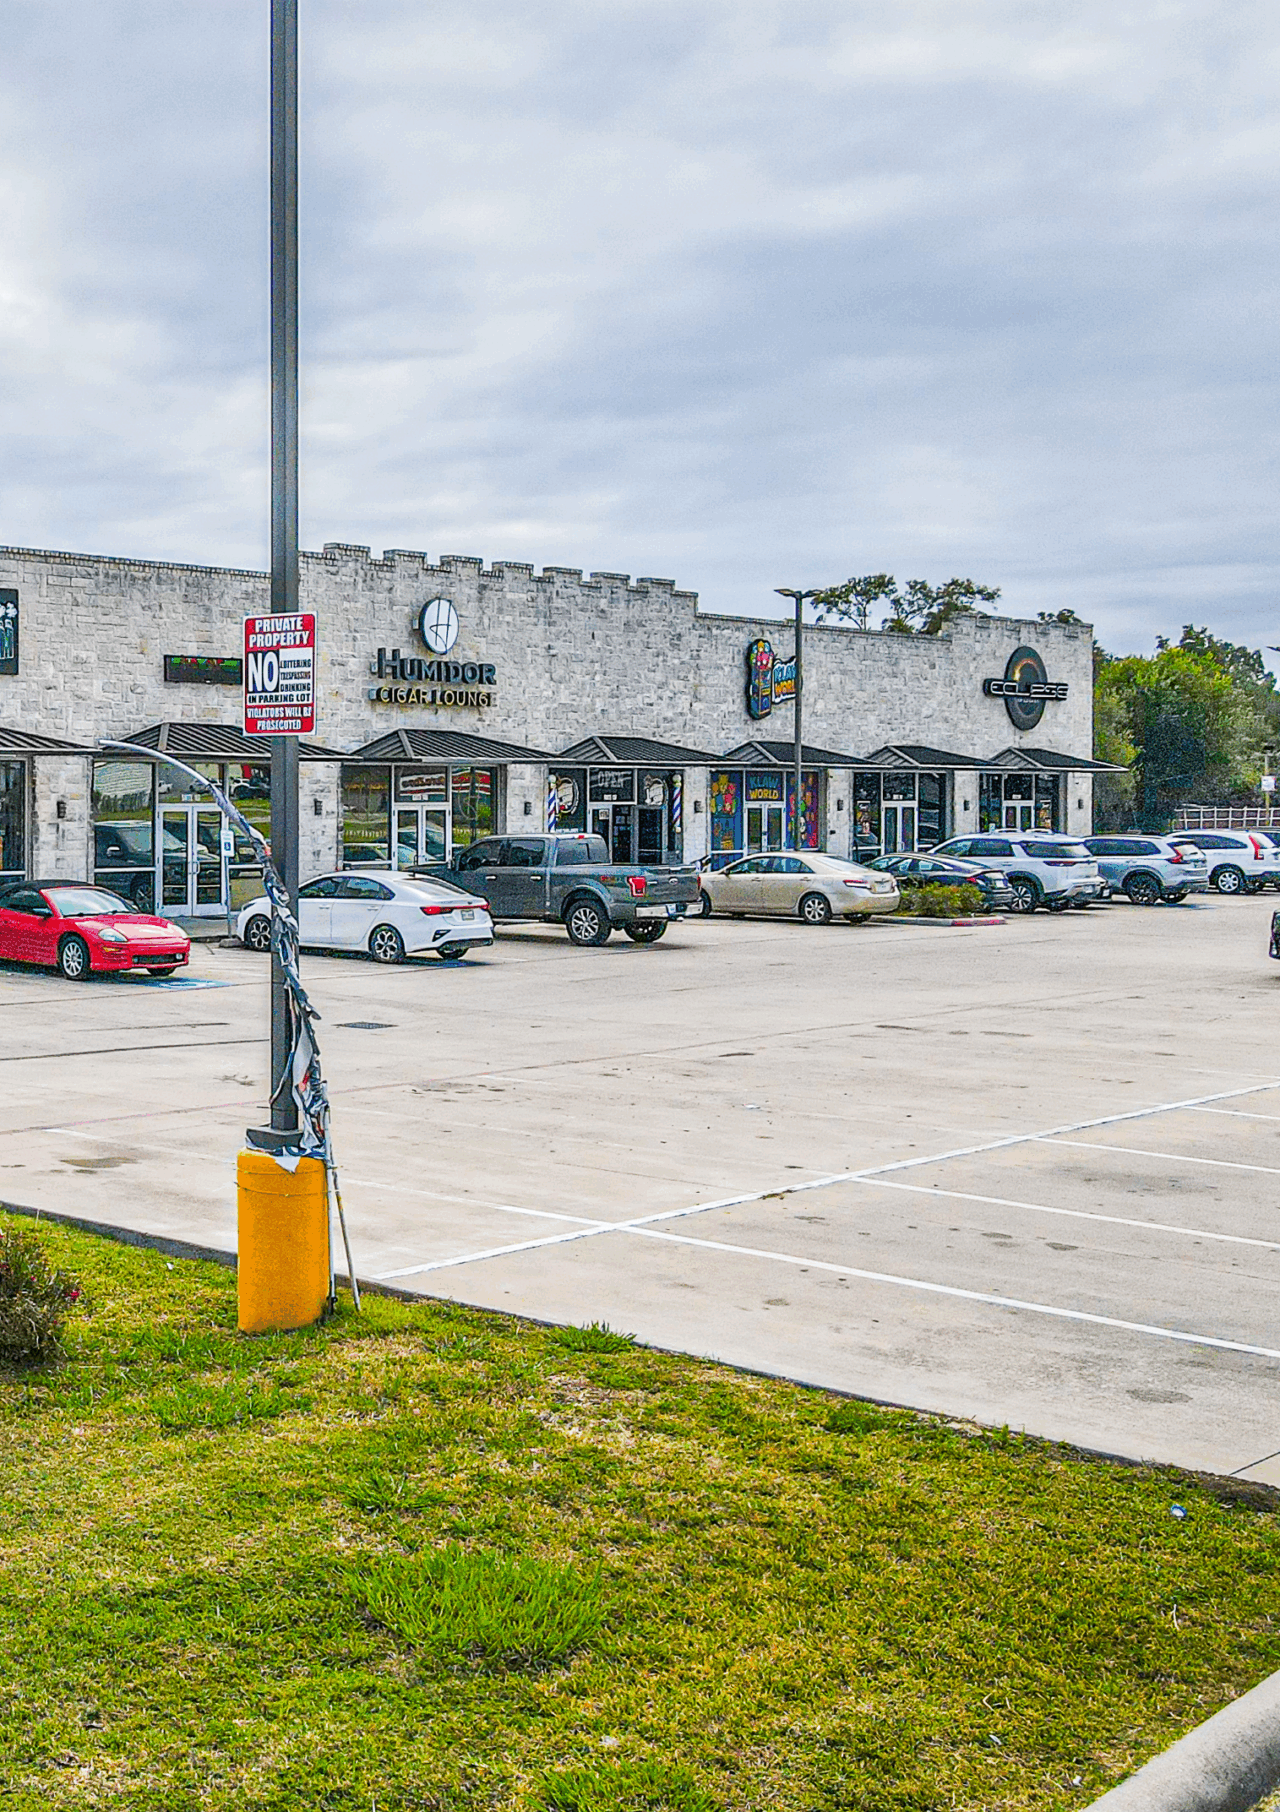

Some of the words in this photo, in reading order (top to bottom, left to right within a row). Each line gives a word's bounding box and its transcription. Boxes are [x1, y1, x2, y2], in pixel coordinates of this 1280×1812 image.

[255, 617, 304, 632] PRIVATE
[249, 631, 310, 648] PROPERTY
[280, 659, 311, 668] LOITERING
[377, 647, 497, 685] HUMIDOR
[248, 651, 279, 692] NO
[280, 683, 311, 692] DRINKING
[990, 681, 1069, 698] ECLPSE
[248, 695, 257, 703] IN
[258, 694, 294, 703] PARKING
[296, 693, 311, 702] LOT
[379, 687, 429, 704] CIGAR
[435, 688, 498, 707] LOUNGE
[247, 707, 284, 718] VIOLATORS
[285, 706, 302, 717] WILL
[257, 720, 302, 730] PROSECUTED
[750, 776, 778, 788] KLAW
[749, 788, 779, 799] WORLD
